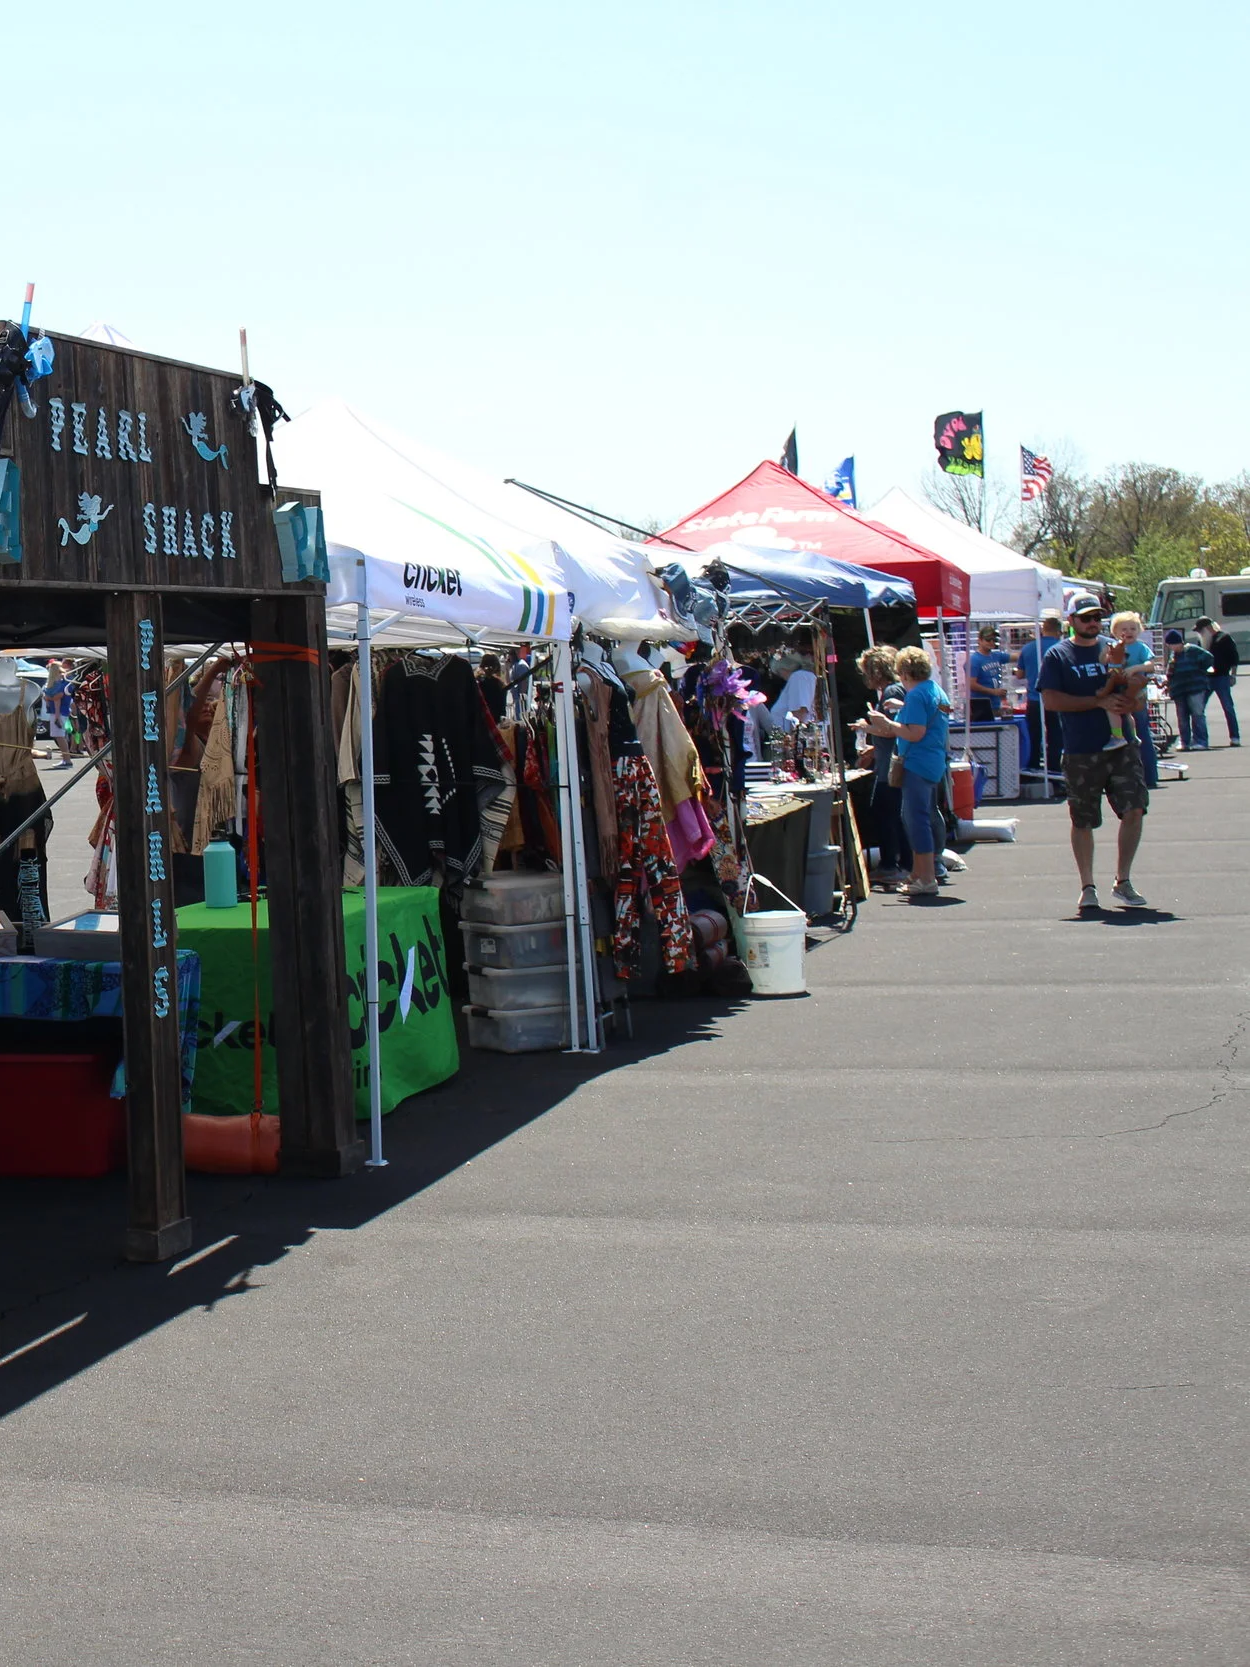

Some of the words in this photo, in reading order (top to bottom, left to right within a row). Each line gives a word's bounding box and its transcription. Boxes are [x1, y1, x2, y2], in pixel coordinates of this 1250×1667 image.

[49, 397, 152, 463] PEARL
[143, 502, 236, 560] SHACK
[680, 511, 759, 533] State
[759, 507, 839, 524] Farm
[403, 561, 463, 597] cricket
[405, 594, 426, 608] wireless
[1071, 662, 1108, 678] YET
